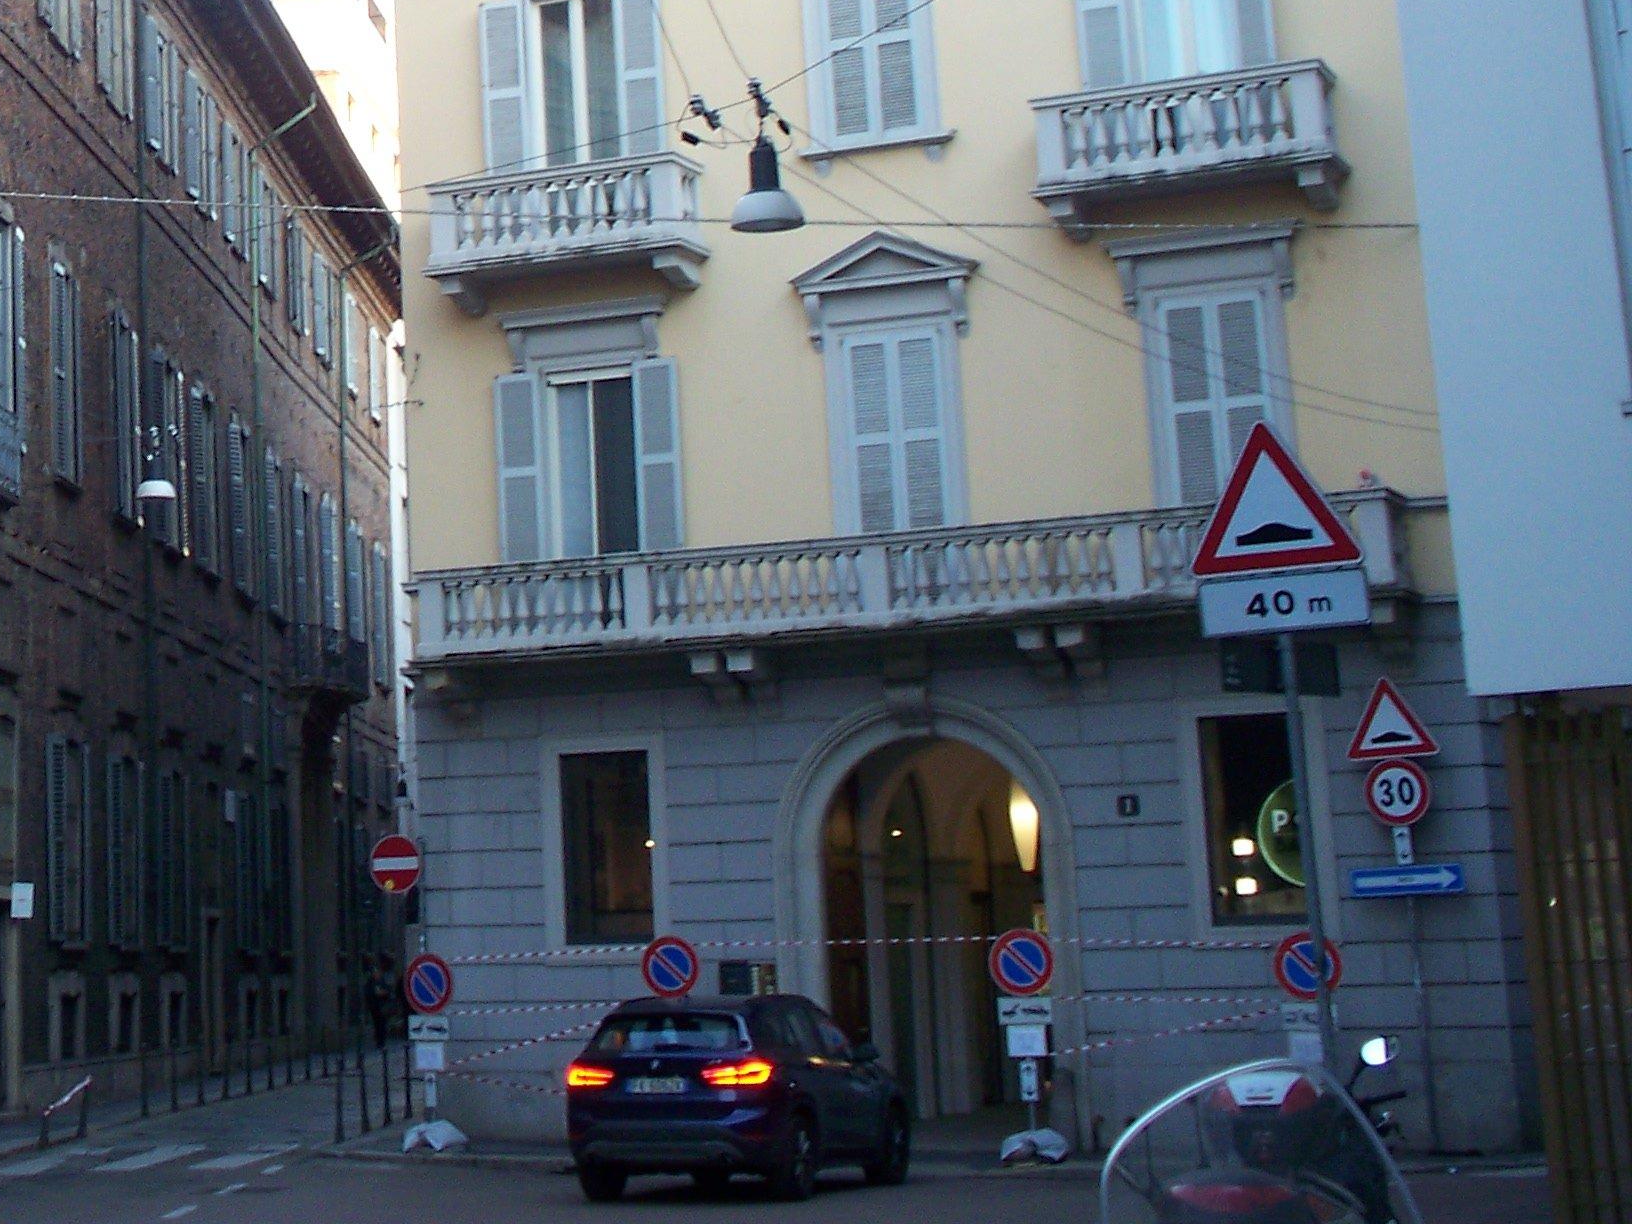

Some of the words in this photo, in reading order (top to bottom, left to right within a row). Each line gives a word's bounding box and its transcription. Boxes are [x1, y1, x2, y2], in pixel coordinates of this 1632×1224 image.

[1246, 590, 1294, 617] 40
[1308, 596, 1331, 613] m
[1379, 777, 1414, 807] 30
